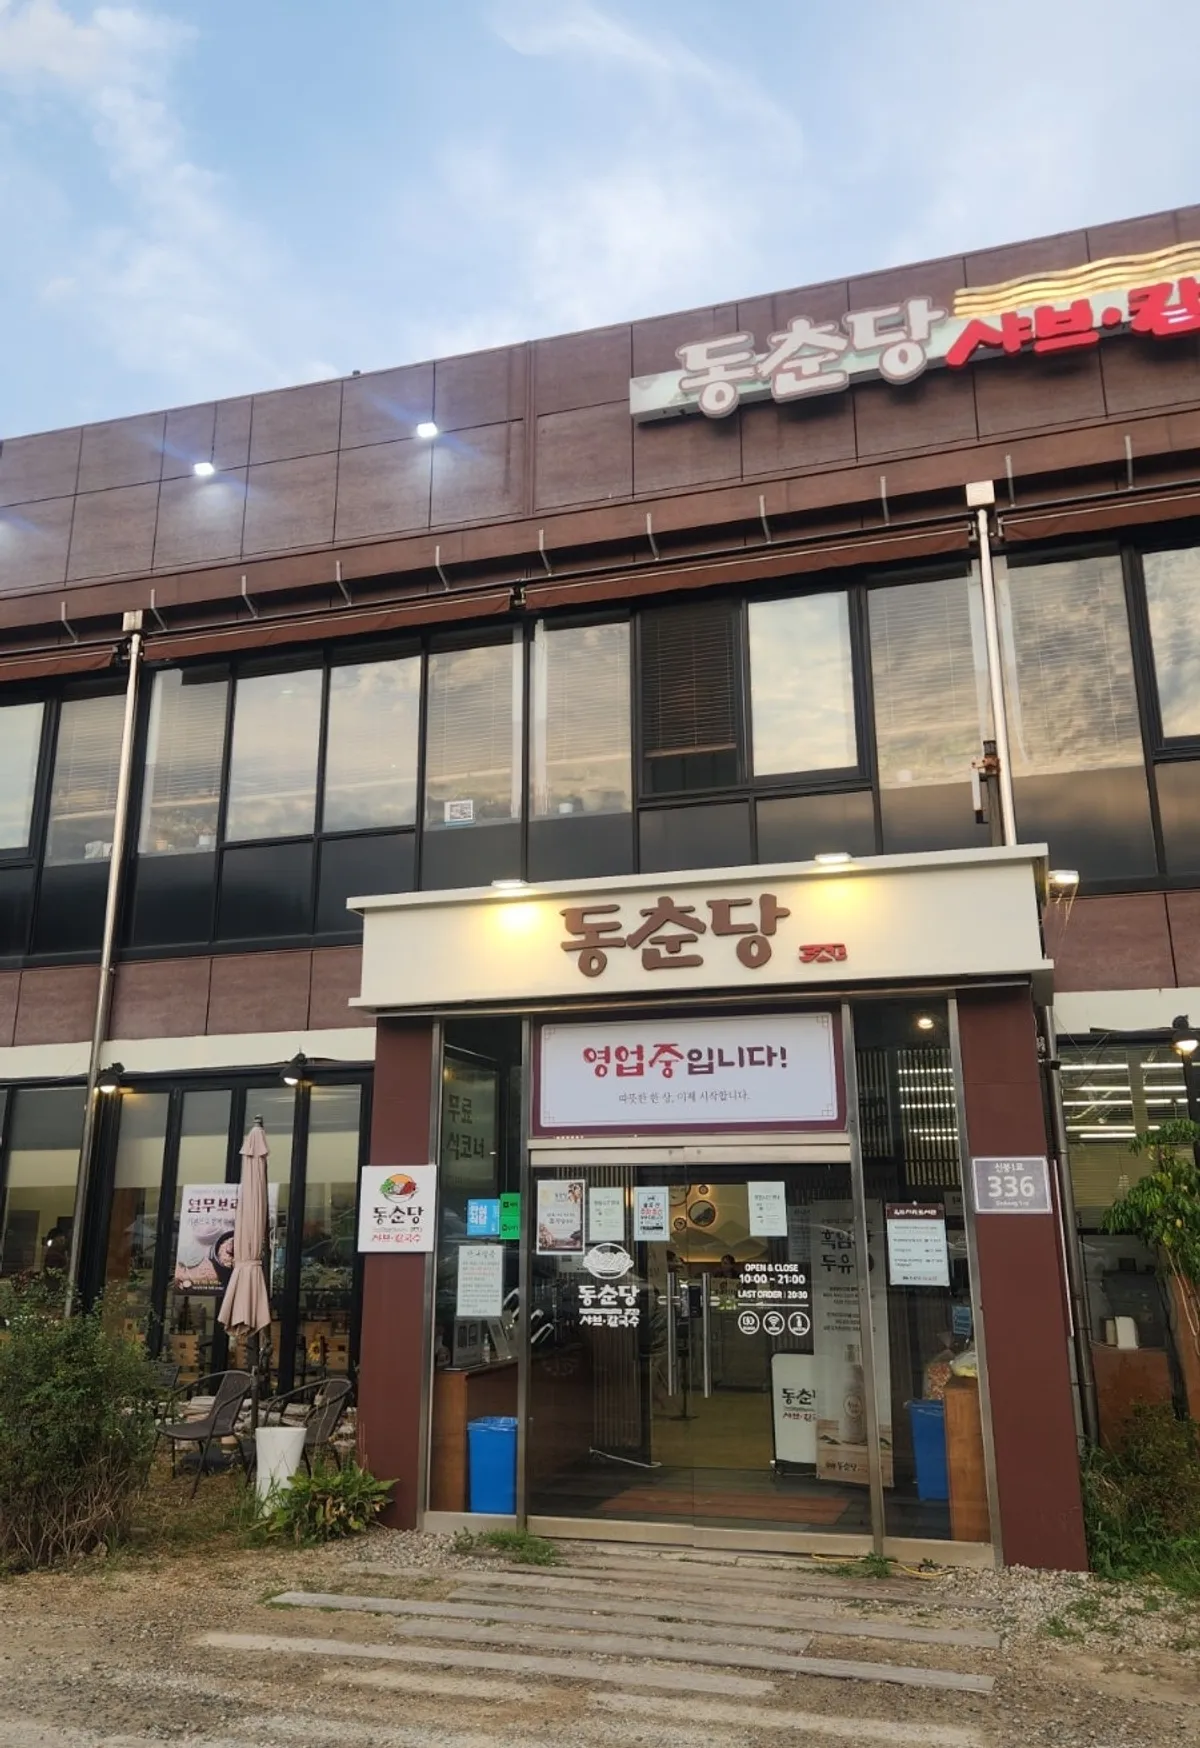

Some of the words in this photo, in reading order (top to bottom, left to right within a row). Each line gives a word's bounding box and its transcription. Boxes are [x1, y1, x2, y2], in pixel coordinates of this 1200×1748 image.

[676, 297, 948, 418] 동춘당
[559, 893, 790, 977] 동춘당
[583, 1043, 788, 1078] 영업중입니다!
[619, 1091, 648, 1104] 따뜻한
[650, 1092, 660, 1104] 한
[987, 1175, 1036, 1198] 336
[744, 1264, 767, 1272] OPEN
[774, 1263, 799, 1272] CLOSE
[820, 1254, 854, 1275] 두유
[739, 1274, 767, 1284] 10:00
[777, 1274, 806, 1284] 21:00
[578, 1284, 641, 1307] 동춘당
[737, 1290, 756, 1299] LAST
[757, 1290, 783, 1299] ORDER
